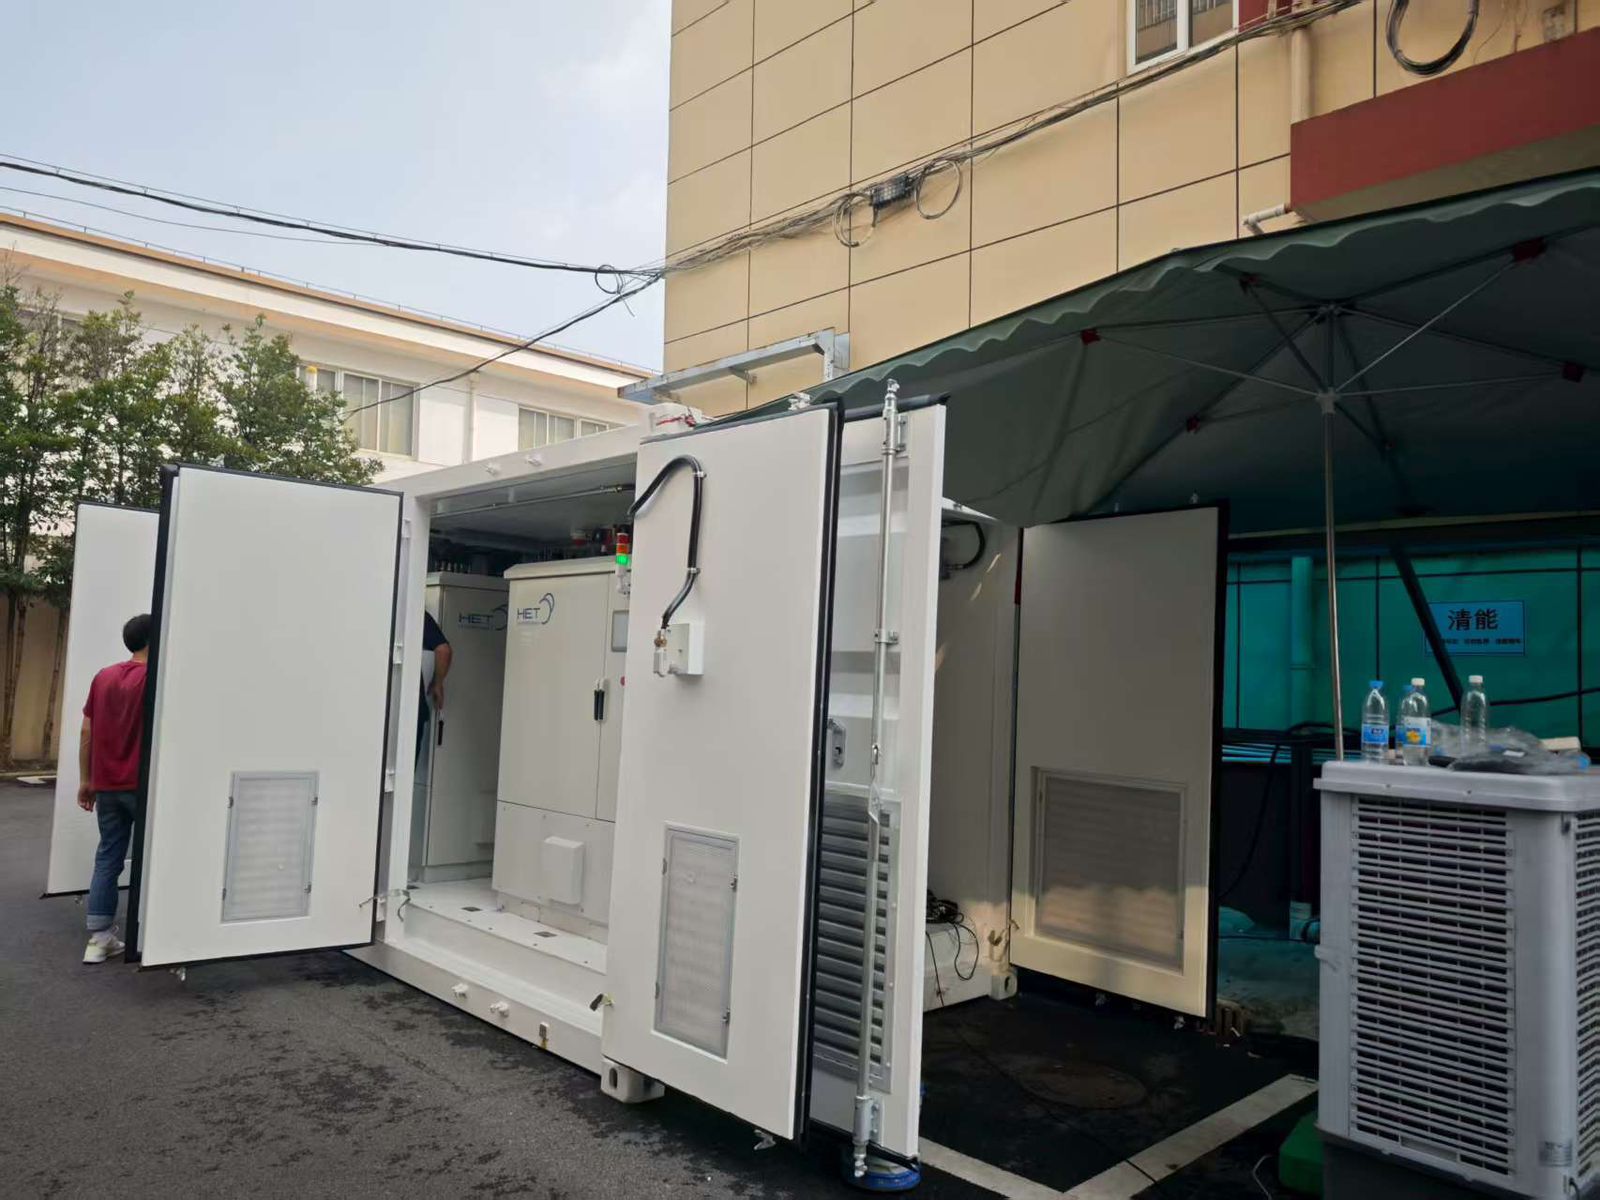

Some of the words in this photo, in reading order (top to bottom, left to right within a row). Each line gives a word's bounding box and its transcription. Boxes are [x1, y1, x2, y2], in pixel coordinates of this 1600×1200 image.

[458, 612, 494, 624] HET
[517, 607, 541, 620] HET
[1447, 607, 1499, 631] 清能
